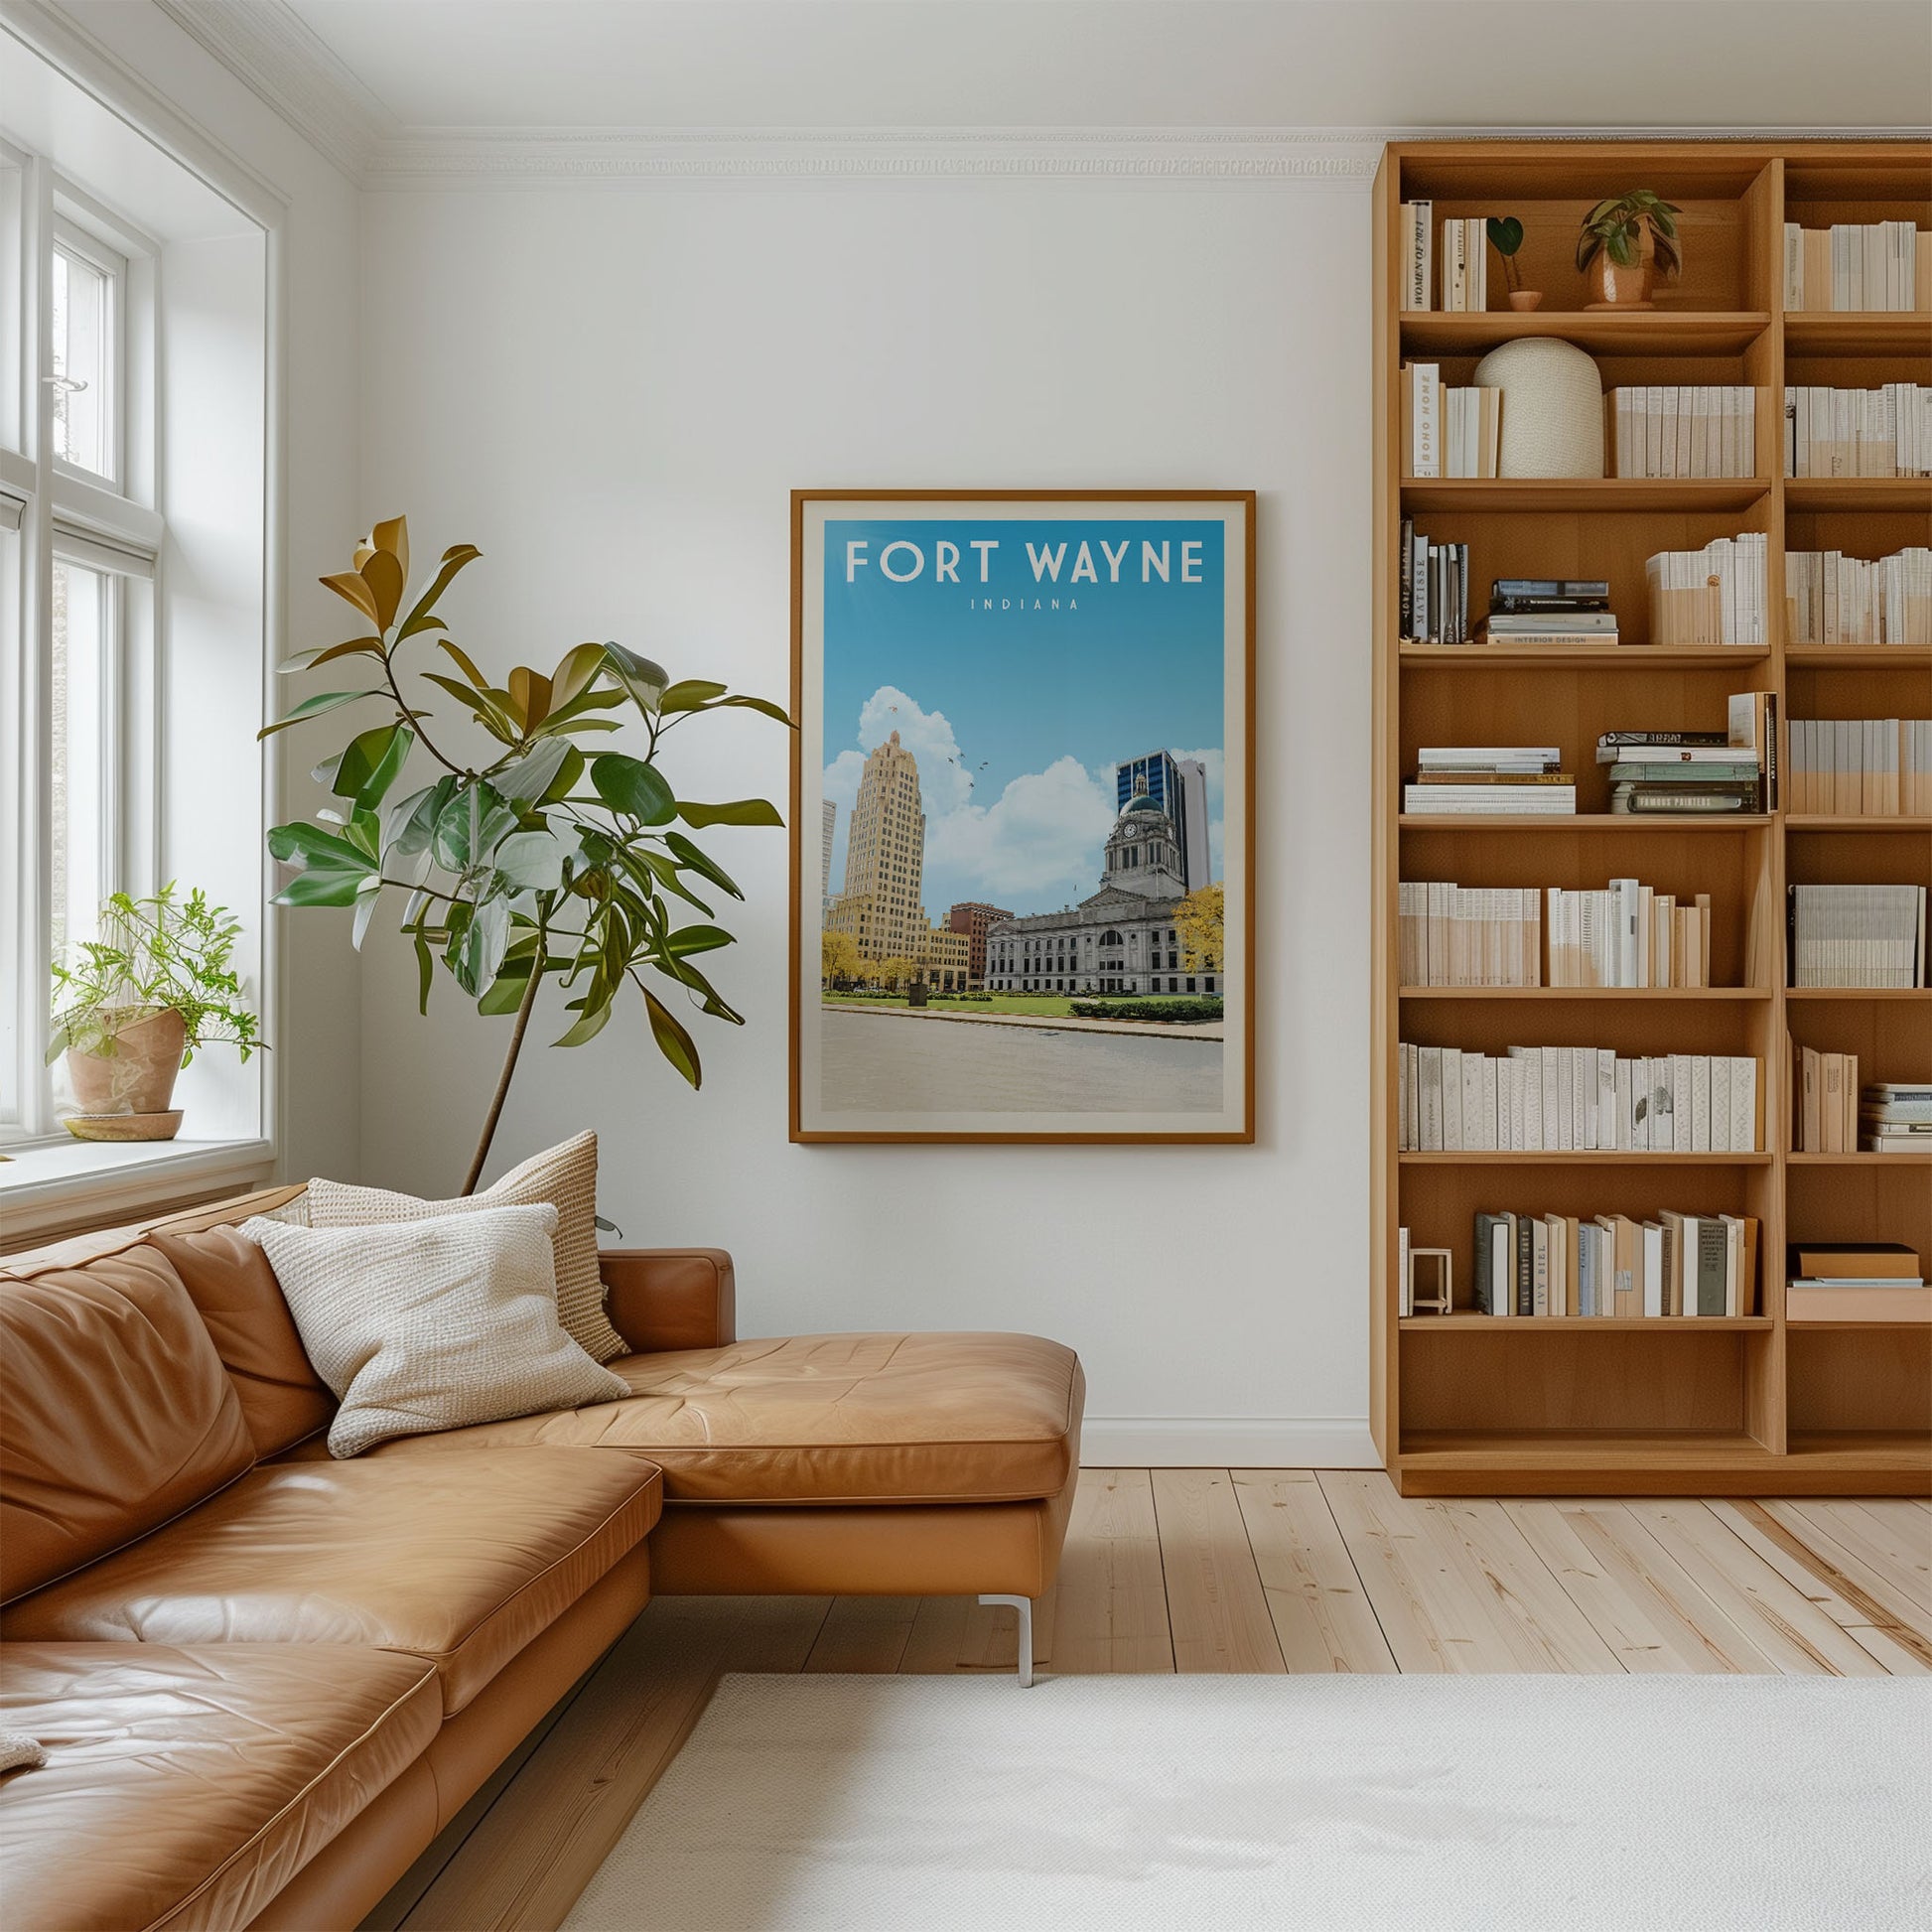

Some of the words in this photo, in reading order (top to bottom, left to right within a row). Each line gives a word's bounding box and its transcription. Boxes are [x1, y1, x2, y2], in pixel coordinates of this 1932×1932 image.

[1415, 245, 1425, 261] OF
[1414, 261, 1424, 305] WOMEN
[1422, 421, 1431, 462] BOHO
[846, 540, 1000, 583] FORT
[1025, 540, 1203, 583] WAYNE
[970, 598, 1079, 611] INDIANA
[1416, 559, 1425, 624] MATISSE
[1639, 797, 1671, 807] FAMOUS
[1674, 797, 1712, 807] PAINTERS
